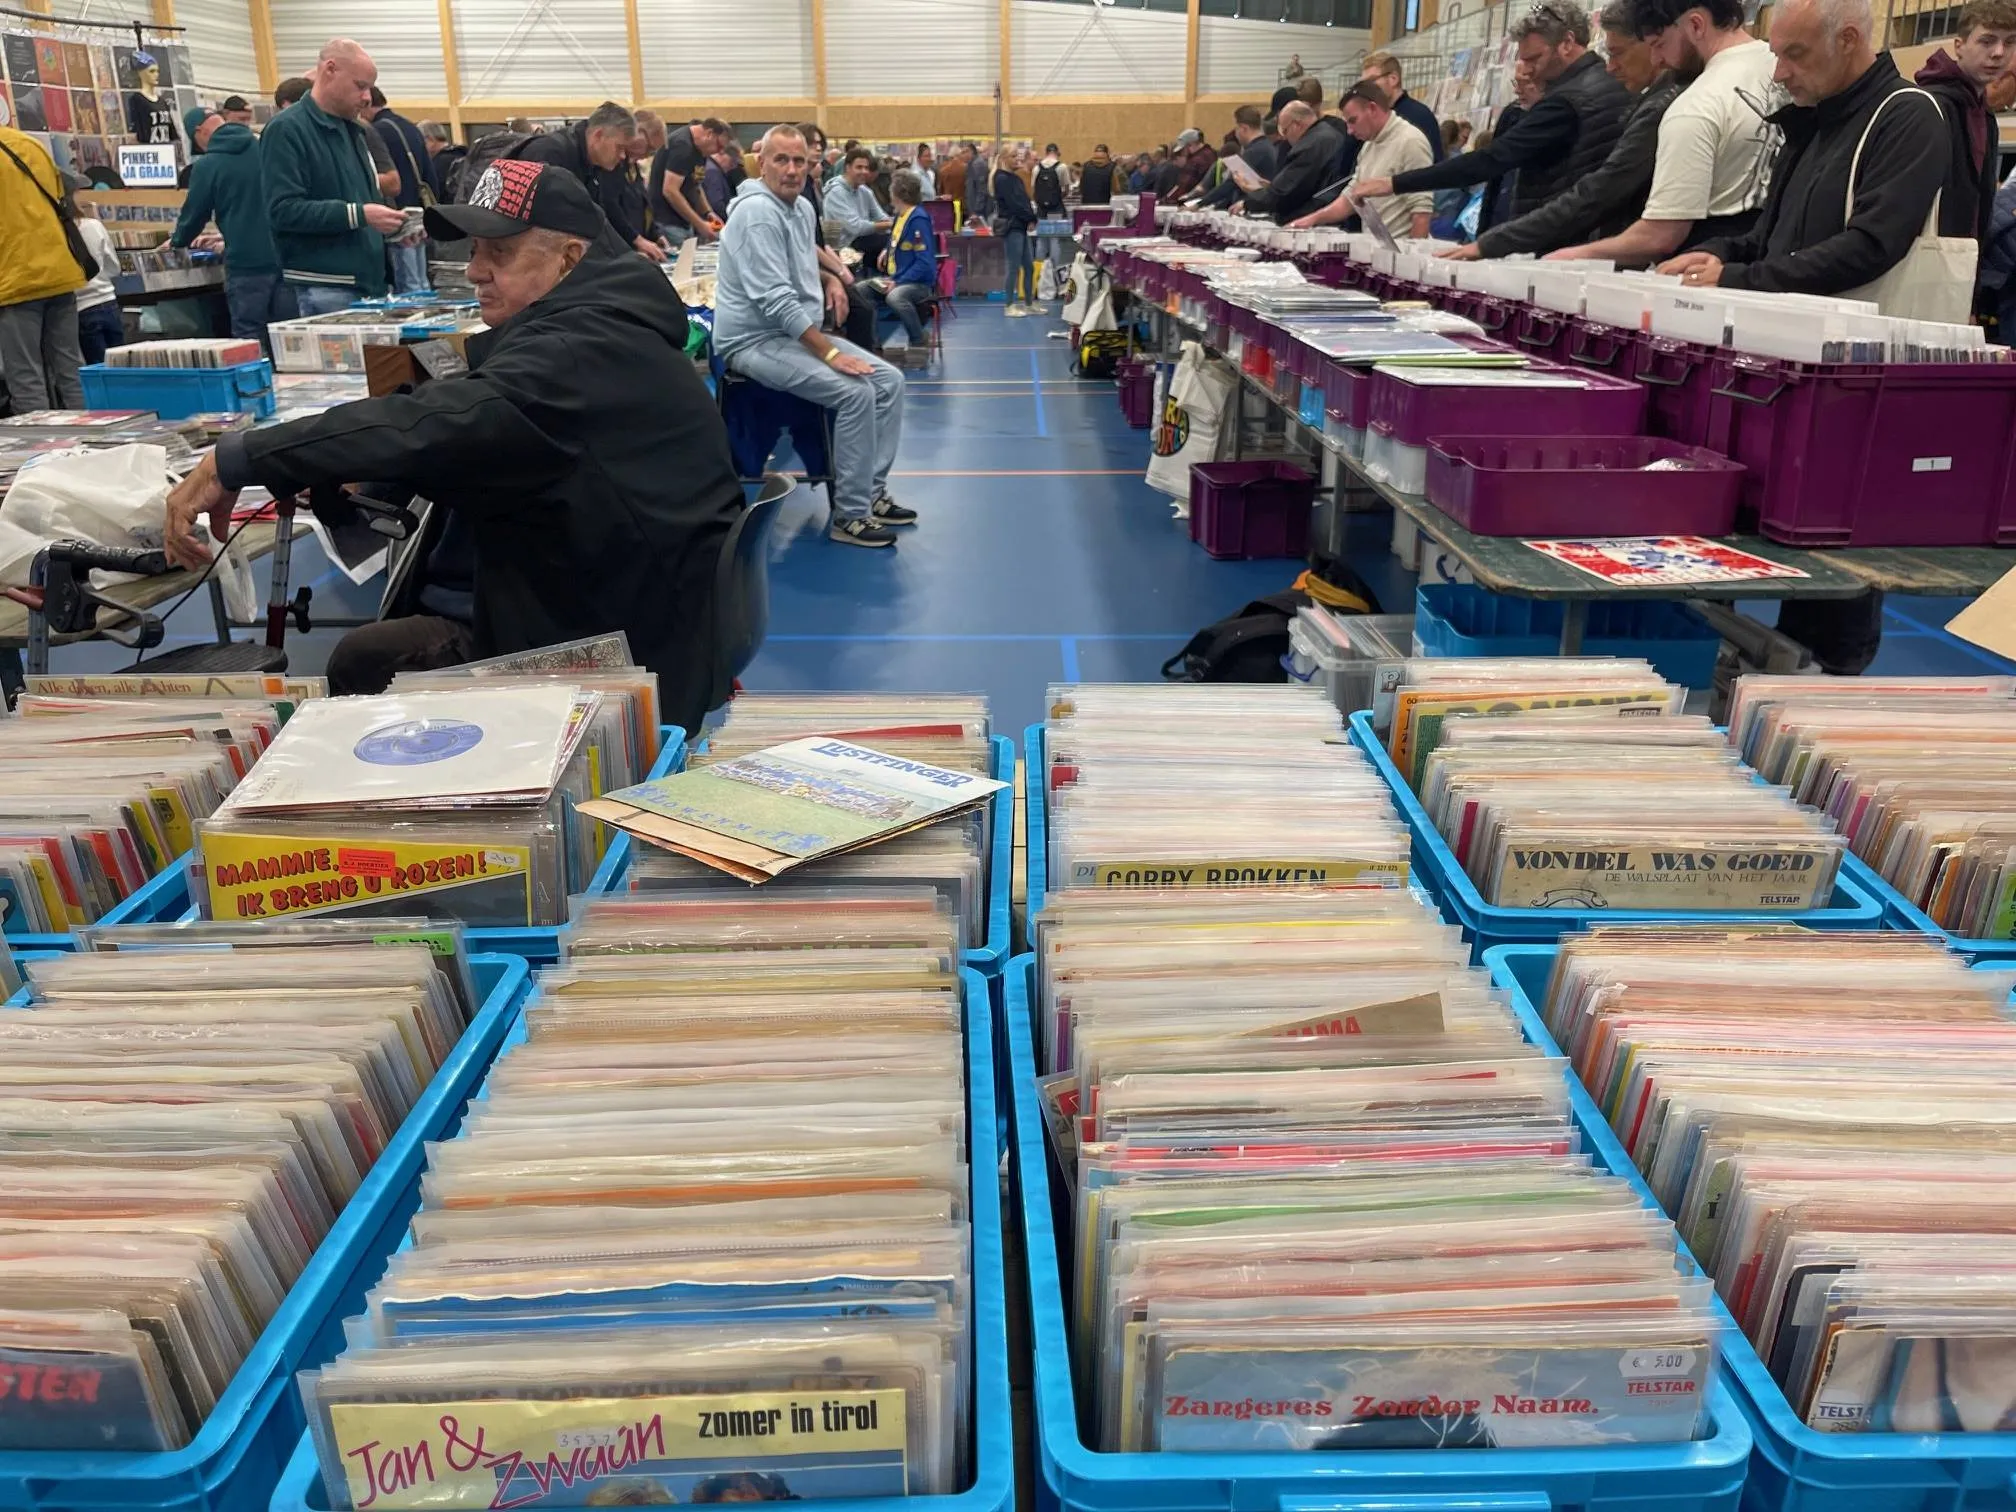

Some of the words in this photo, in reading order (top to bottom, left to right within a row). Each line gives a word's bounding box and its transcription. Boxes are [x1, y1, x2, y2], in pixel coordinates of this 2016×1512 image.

[122, 151, 160, 164] PINNEN
[123, 166, 136, 178] JA
[140, 165, 174, 178] GRAAG
[38, 677, 63, 693] Alle
[114, 677, 134, 694] alle
[810, 742, 973, 788] LUSTFINGER
[1512, 850, 1636, 871] VONDEL
[1651, 852, 1717, 871] WAS
[1727, 853, 1814, 871] GOED
[1605, 873, 1620, 882] DE
[1627, 873, 1701, 883] WALSPLAAT
[1706, 873, 1733, 882] VAN
[1739, 873, 1768, 882] HET
[1773, 873, 1808, 884] JAAR
[237, 892, 266, 917] IK
[270, 875, 359, 911] BRENG
[364, 876, 381, 893] U
[1759, 895, 1800, 904] TELSTAR
[1627, 1381, 1695, 1394] TELSTAR
[1165, 1395, 1333, 1420] Zangeres
[1352, 1395, 1481, 1417] Zonder
[1491, 1394, 1600, 1414] Naam.
[698, 1409, 781, 1438] zomer
[790, 1402, 814, 1433] in
[821, 1400, 878, 1432] tirol
[347, 1440, 435, 1508] Jan
[439, 1414, 496, 1472] &
